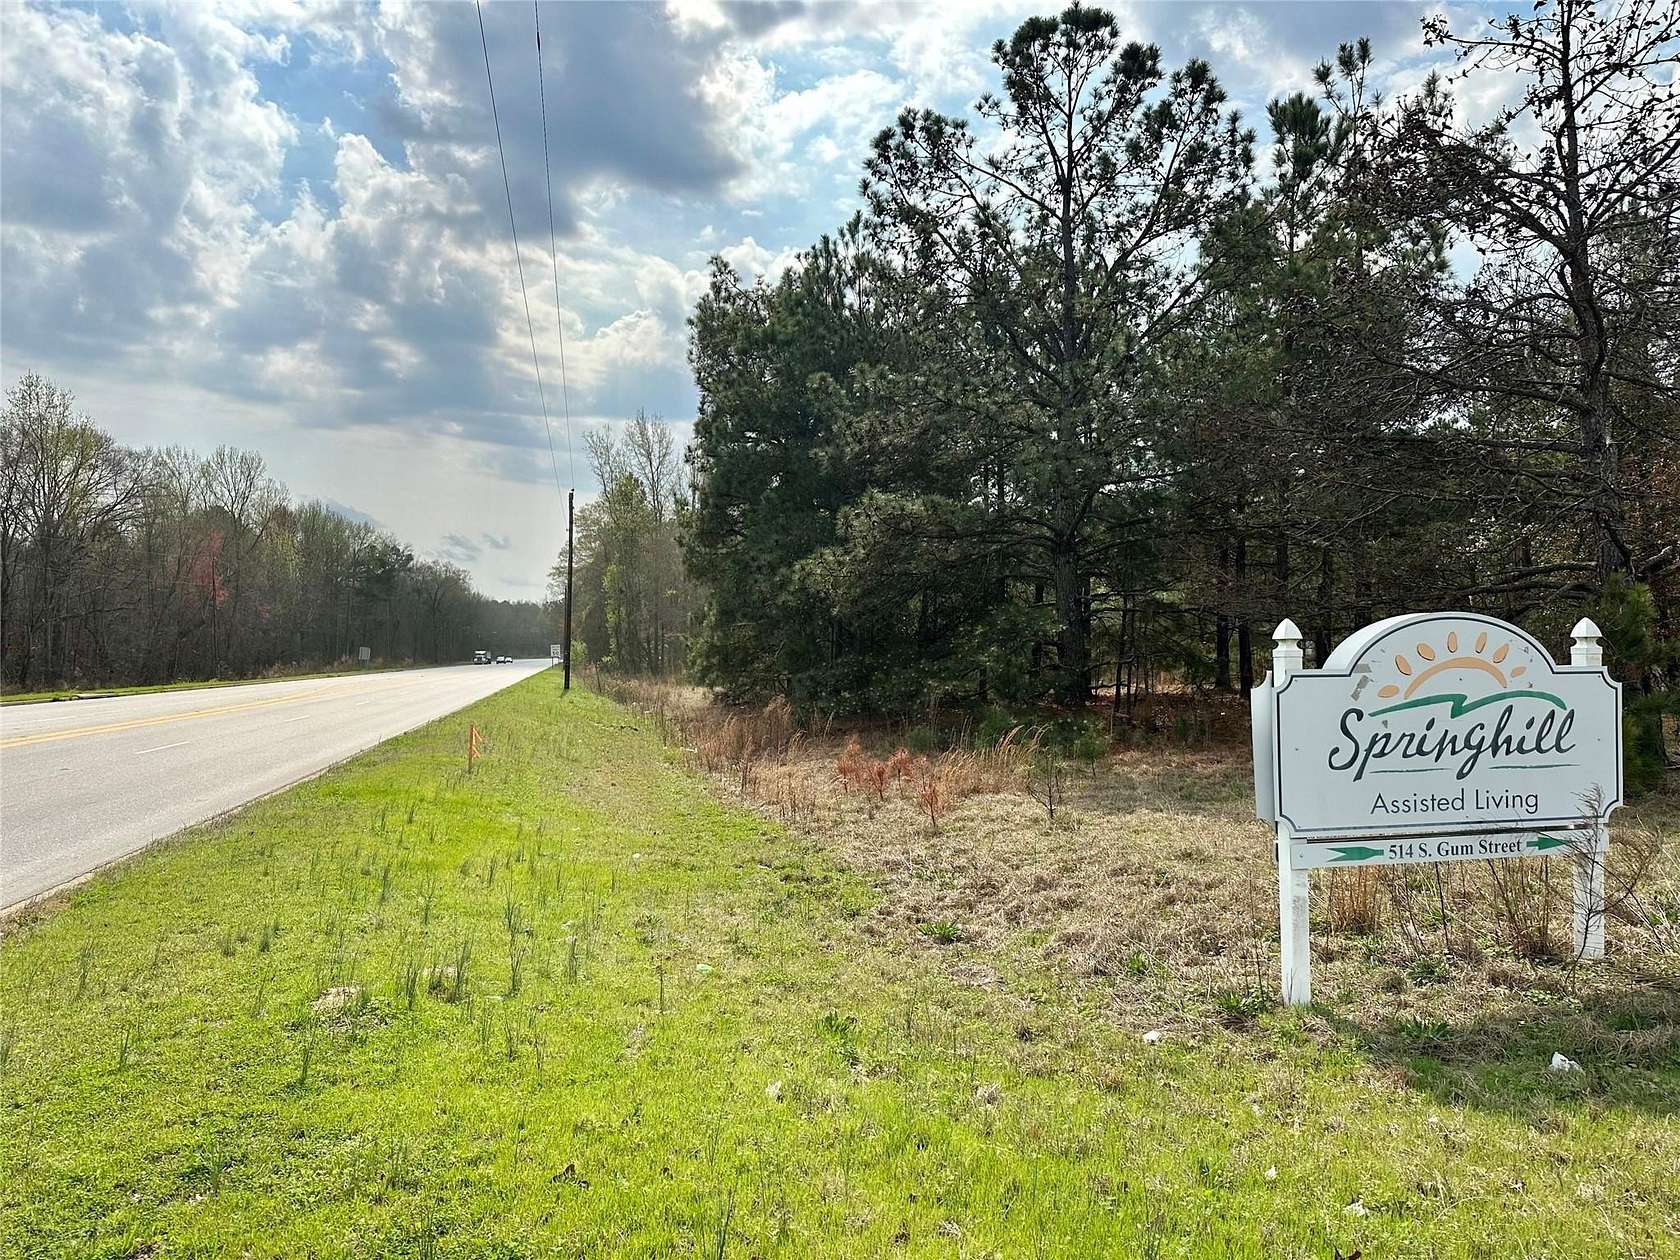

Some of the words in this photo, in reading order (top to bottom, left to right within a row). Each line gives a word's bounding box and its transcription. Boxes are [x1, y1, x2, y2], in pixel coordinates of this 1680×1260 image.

[1328, 704, 1577, 782] Springhill
[1370, 788, 1465, 815] Assisted
[1475, 788, 1539, 814] Living
[1389, 844, 1414, 860] 514
[1418, 842, 1432, 858] S.
[1437, 841, 1474, 857] Gum
[1478, 839, 1523, 855] Street
